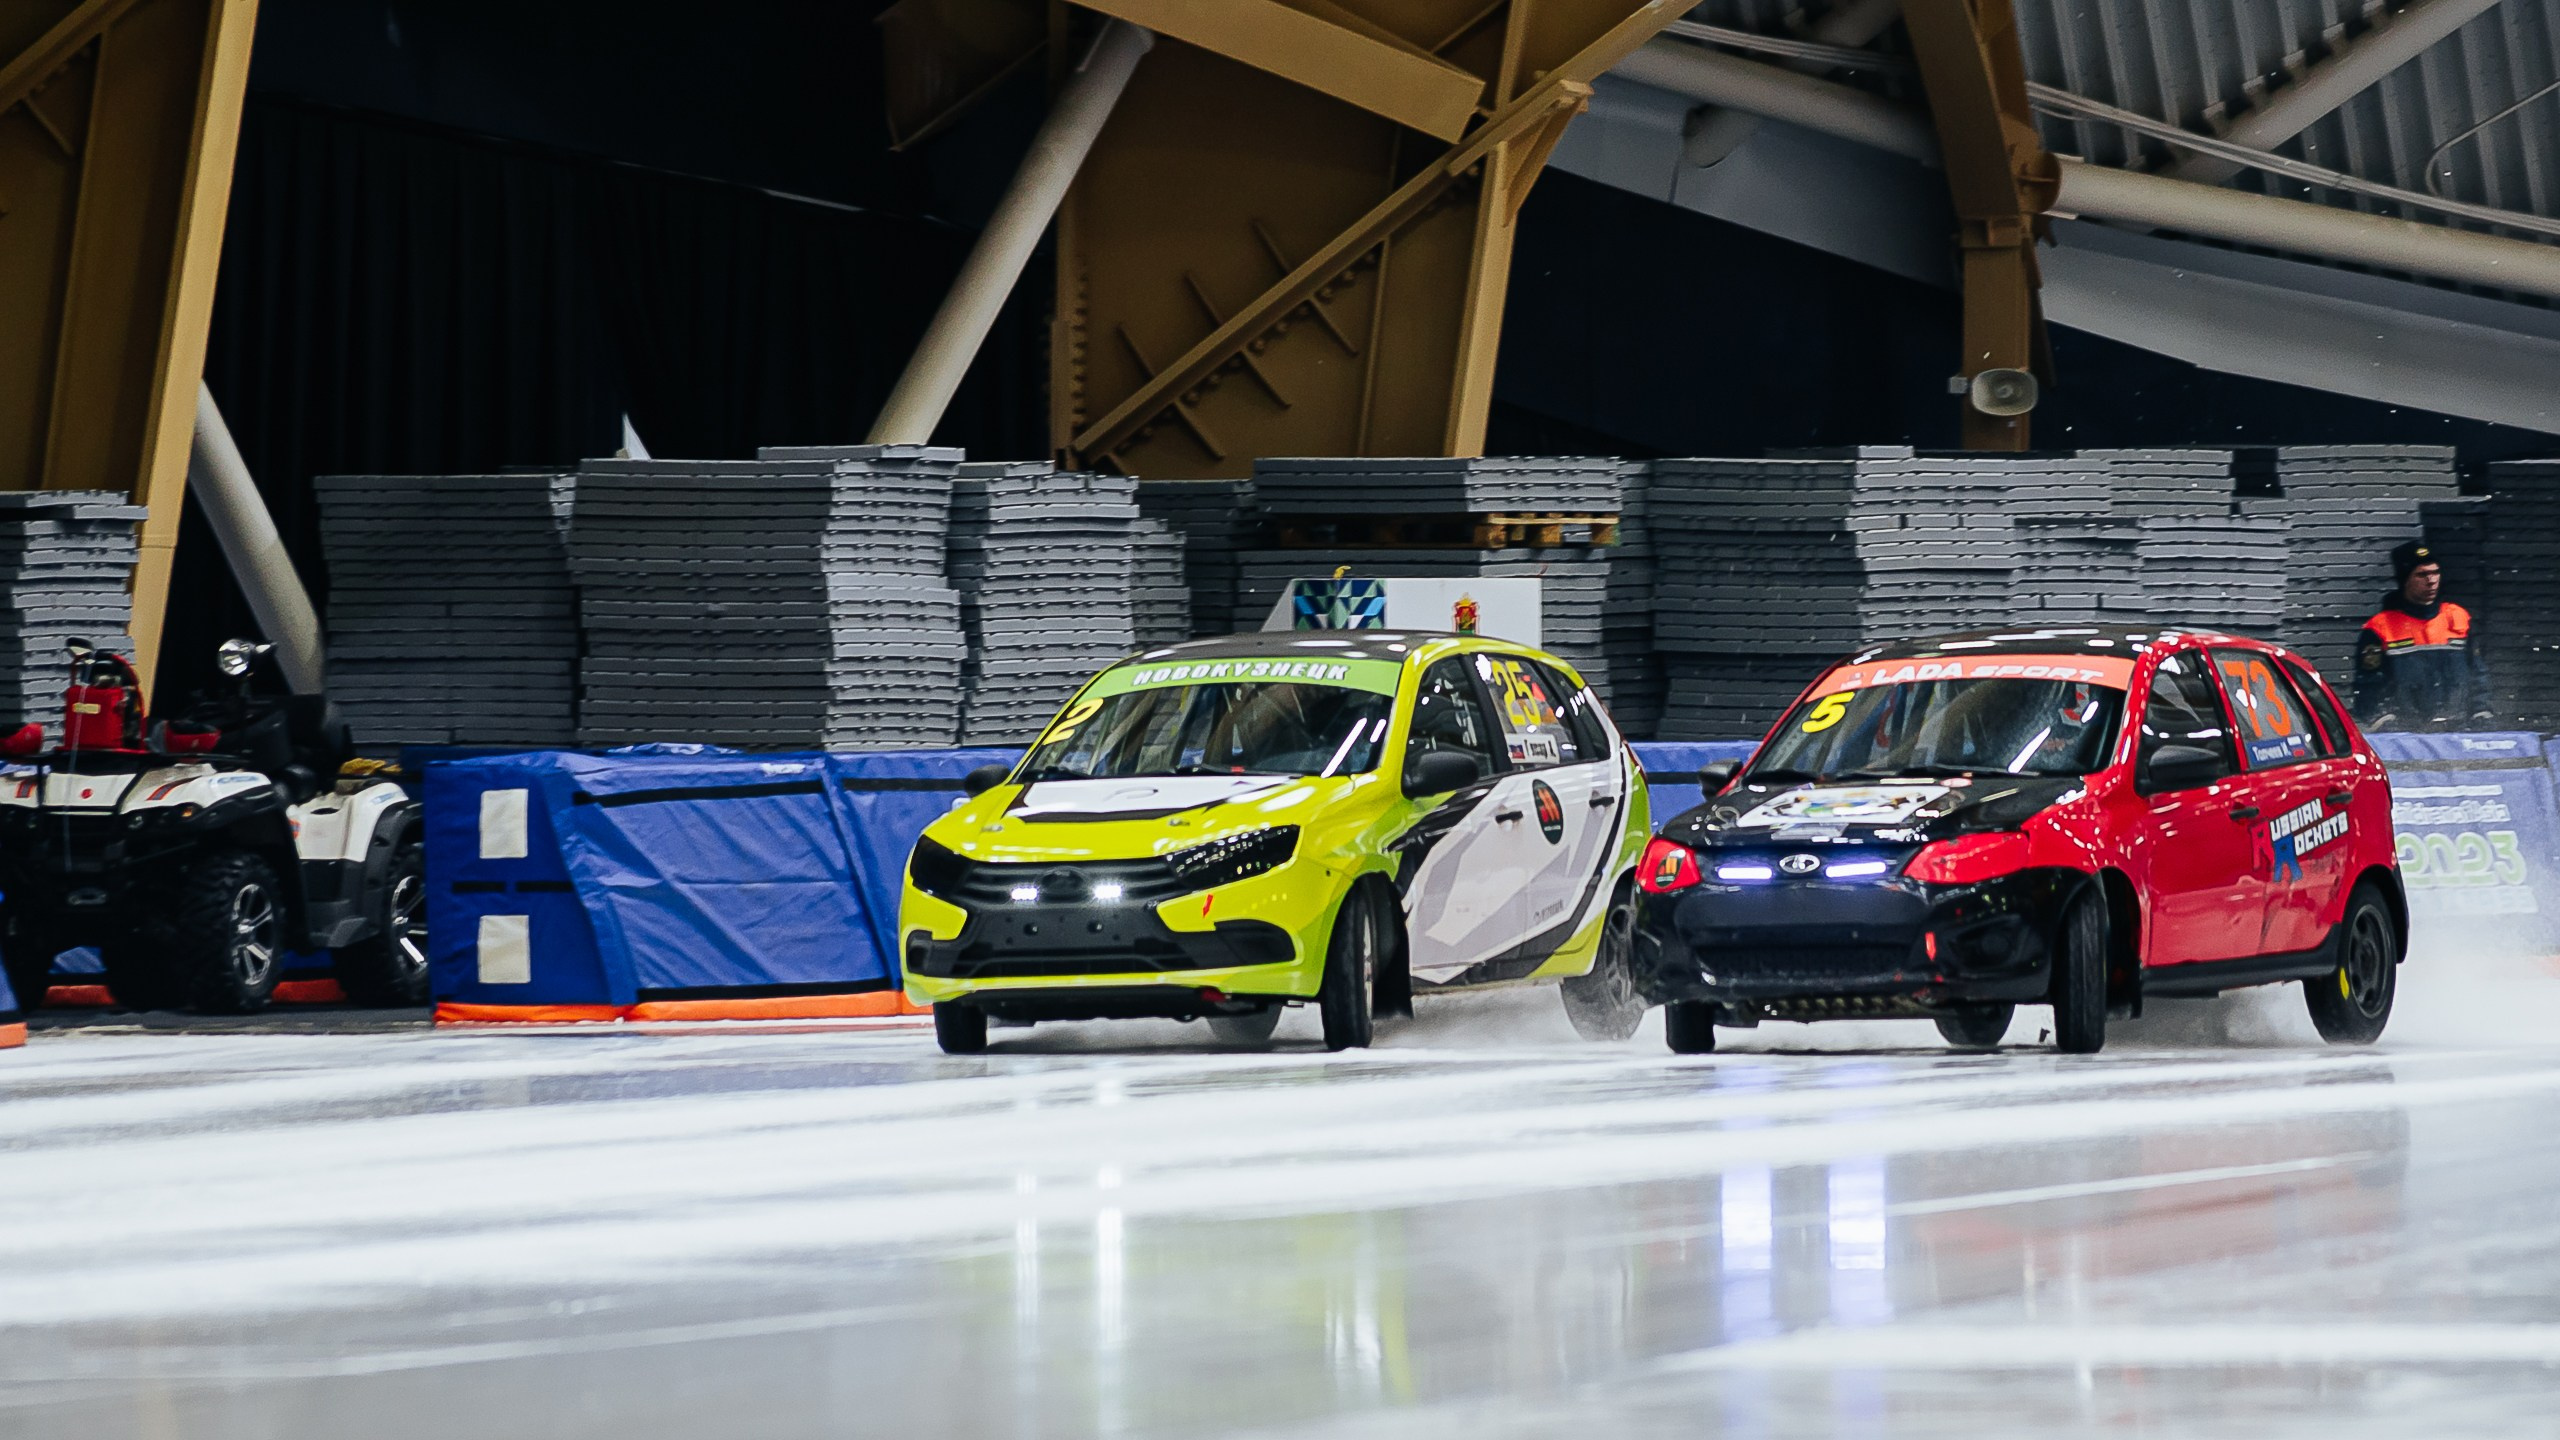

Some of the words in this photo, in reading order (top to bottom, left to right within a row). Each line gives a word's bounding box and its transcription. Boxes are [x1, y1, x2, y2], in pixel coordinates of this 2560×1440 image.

[1132, 661, 1351, 686] НОВОКУЗНЕЦК
[1491, 660, 1542, 727] 25
[1871, 662, 1963, 686] LADA
[1970, 664, 2104, 685] SPORT
[1042, 697, 1104, 746] 2
[1801, 691, 1855, 733] 5
[2223, 660, 2291, 737] 73
[2395, 830, 2528, 886] 2023
